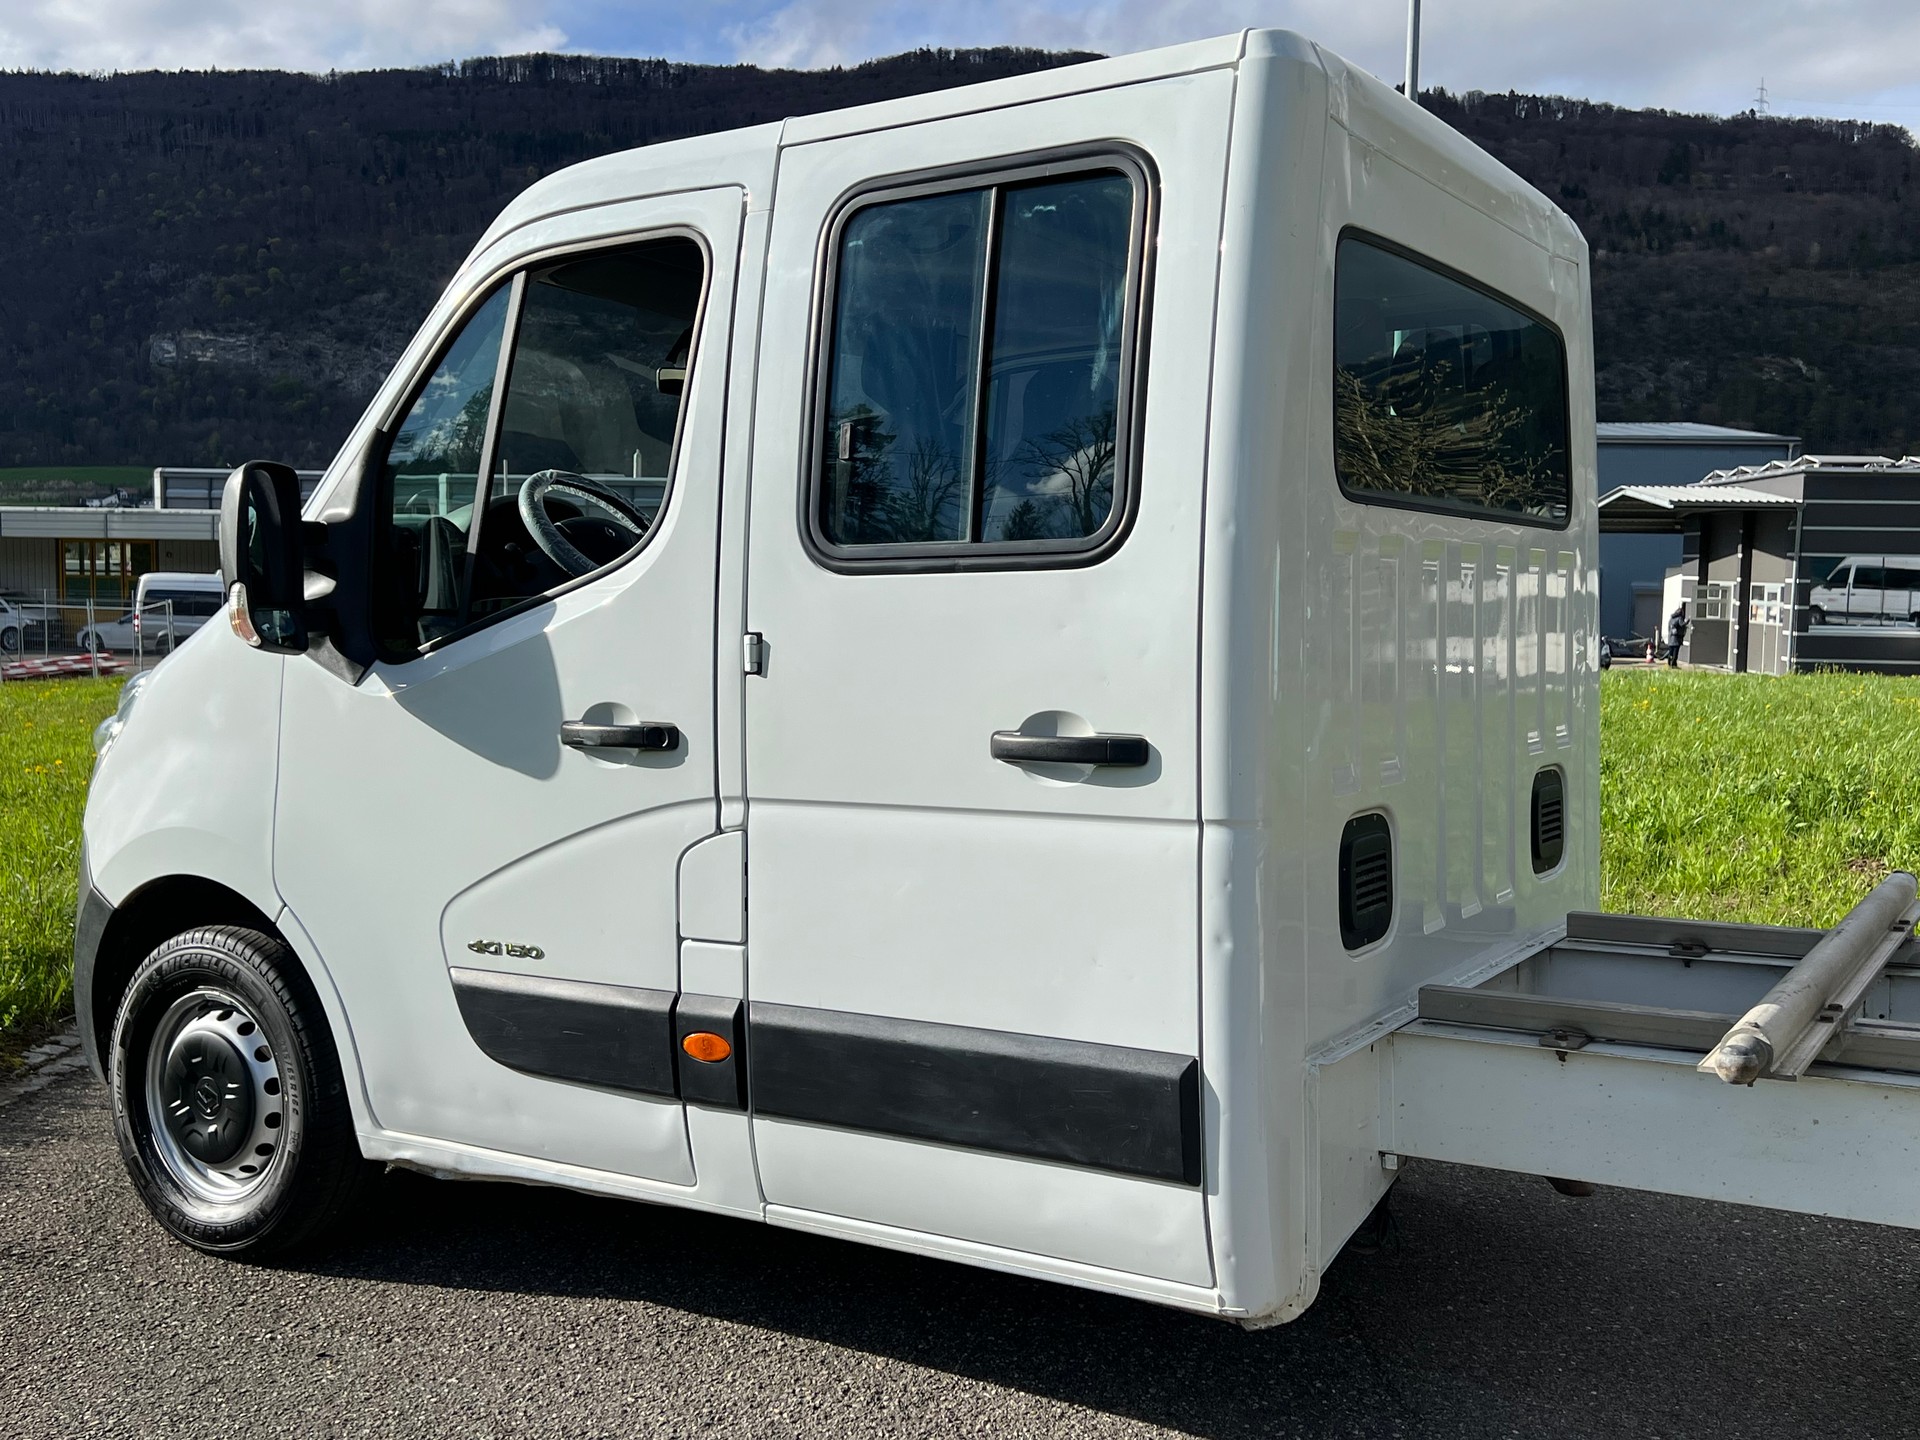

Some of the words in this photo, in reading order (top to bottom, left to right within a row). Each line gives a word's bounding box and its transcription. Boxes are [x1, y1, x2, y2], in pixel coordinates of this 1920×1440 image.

[505, 943, 545, 960] 150
[161, 953, 240, 981] MICHELIN
[168, 1211, 246, 1240] MICHELIN
